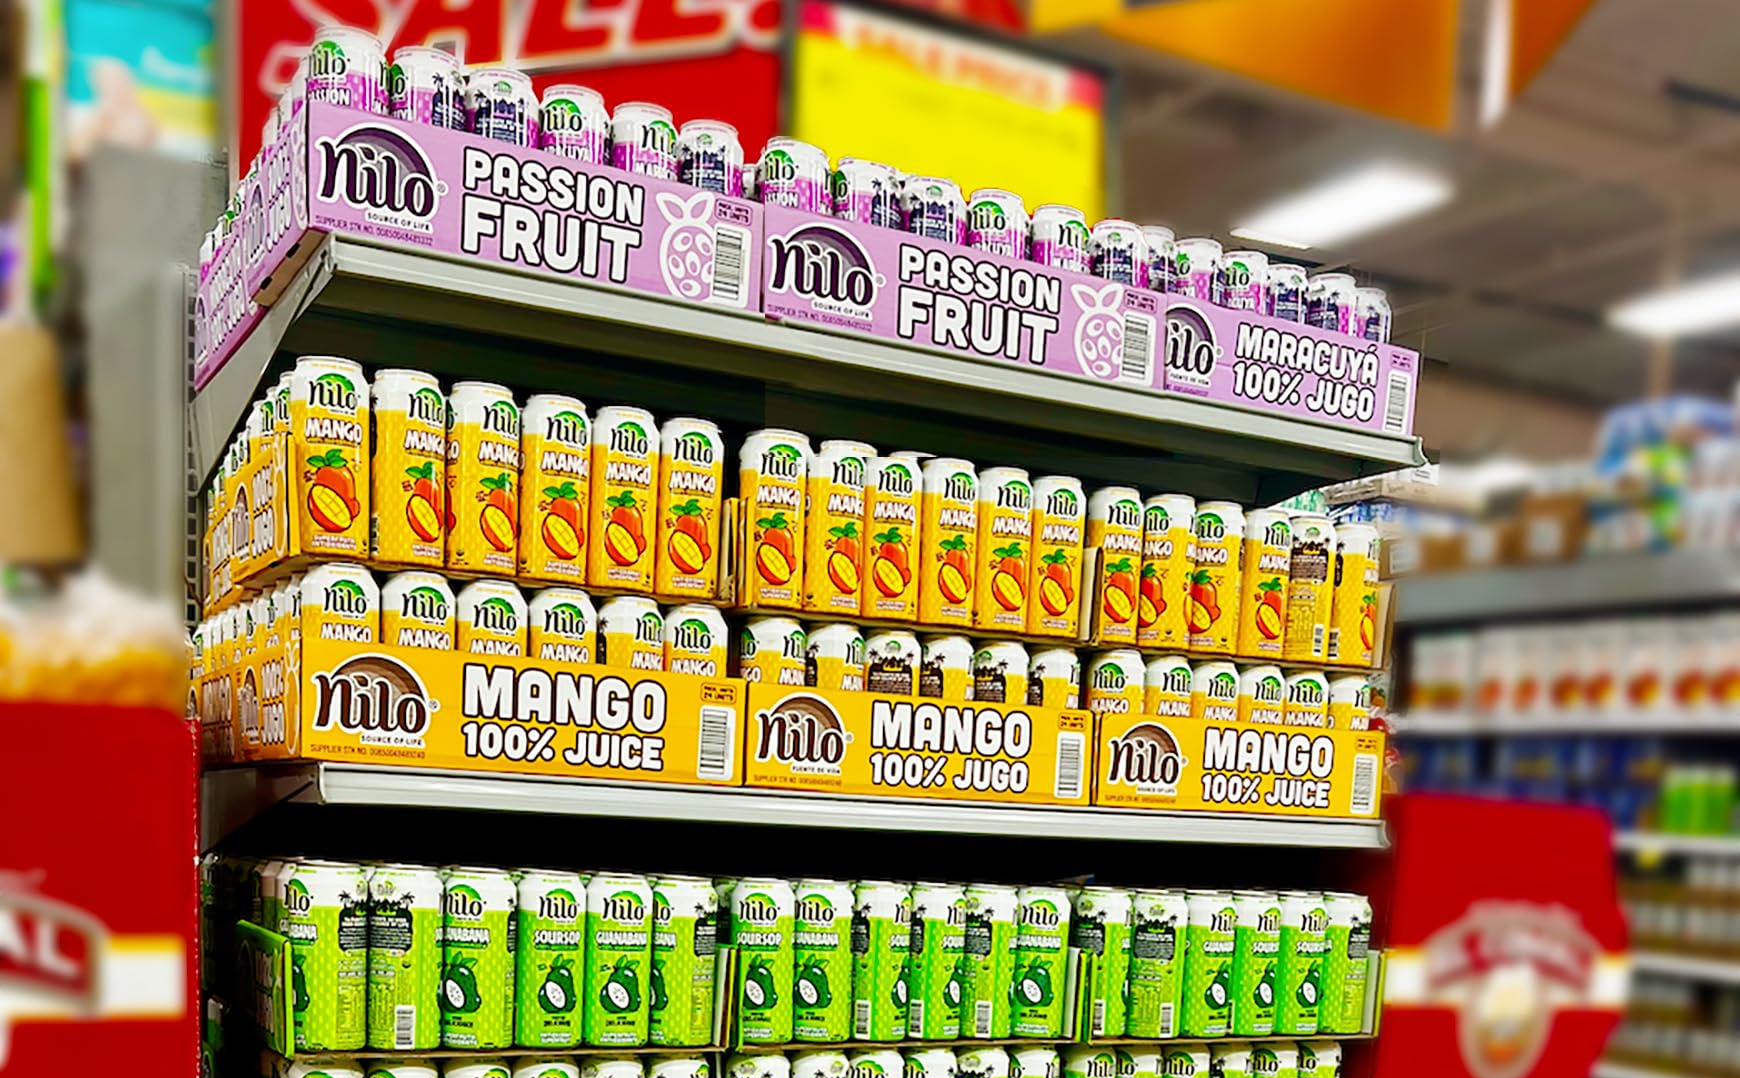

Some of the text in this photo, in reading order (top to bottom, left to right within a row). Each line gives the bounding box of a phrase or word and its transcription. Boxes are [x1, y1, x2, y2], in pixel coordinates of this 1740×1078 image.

[320, 140, 435, 217] nilo
[464, 146, 645, 225] PASSION
[461, 192, 641, 282] FRUIT
[772, 239, 874, 306] nilo
[900, 242, 1061, 314] PASSION
[898, 284, 1059, 364] FRUIT
[1166, 323, 1214, 376] ilo
[1234, 322, 1380, 387] MARACUYÁ
[308, 380, 360, 409] nilo
[1232, 360, 1374, 422] 100% JUGO
[305, 417, 362, 443] MANGO
[610, 427, 648, 455] nilo
[673, 437, 713, 464] nilo
[606, 462, 650, 485] MANGO
[760, 452, 798, 478] nilo
[669, 471, 715, 494] MANGO
[879, 468, 912, 494] nilo
[324, 587, 368, 615] nilo
[401, 592, 448, 621] nilo
[320, 622, 372, 642] MANGO
[474, 604, 518, 632] nilo
[544, 610, 587, 636] nilo
[399, 628, 451, 650] MANGO
[673, 626, 712, 650] nilo
[541, 643, 589, 663] MANGO
[671, 659, 716, 677] MANGO
[1092, 668, 1125, 690] nilo
[316, 674, 427, 733] nilo
[462, 662, 667, 733] MANGO
[1289, 684, 1323, 704] nilo
[758, 712, 843, 764] nilo
[870, 699, 1032, 758] MANGO
[461, 720, 664, 771] 100% JUICE
[1202, 727, 1334, 778] MANGO
[870, 752, 1029, 793] 100% JUGO
[1110, 739, 1179, 784] nilo
[1201, 773, 1331, 808] 100% JUICE
[538, 896, 578, 921] nilo
[603, 897, 645, 923] nilo
[740, 901, 779, 923] nilo
[1022, 904, 1060, 926] nilo
[534, 930, 580, 946] SOURSOP
